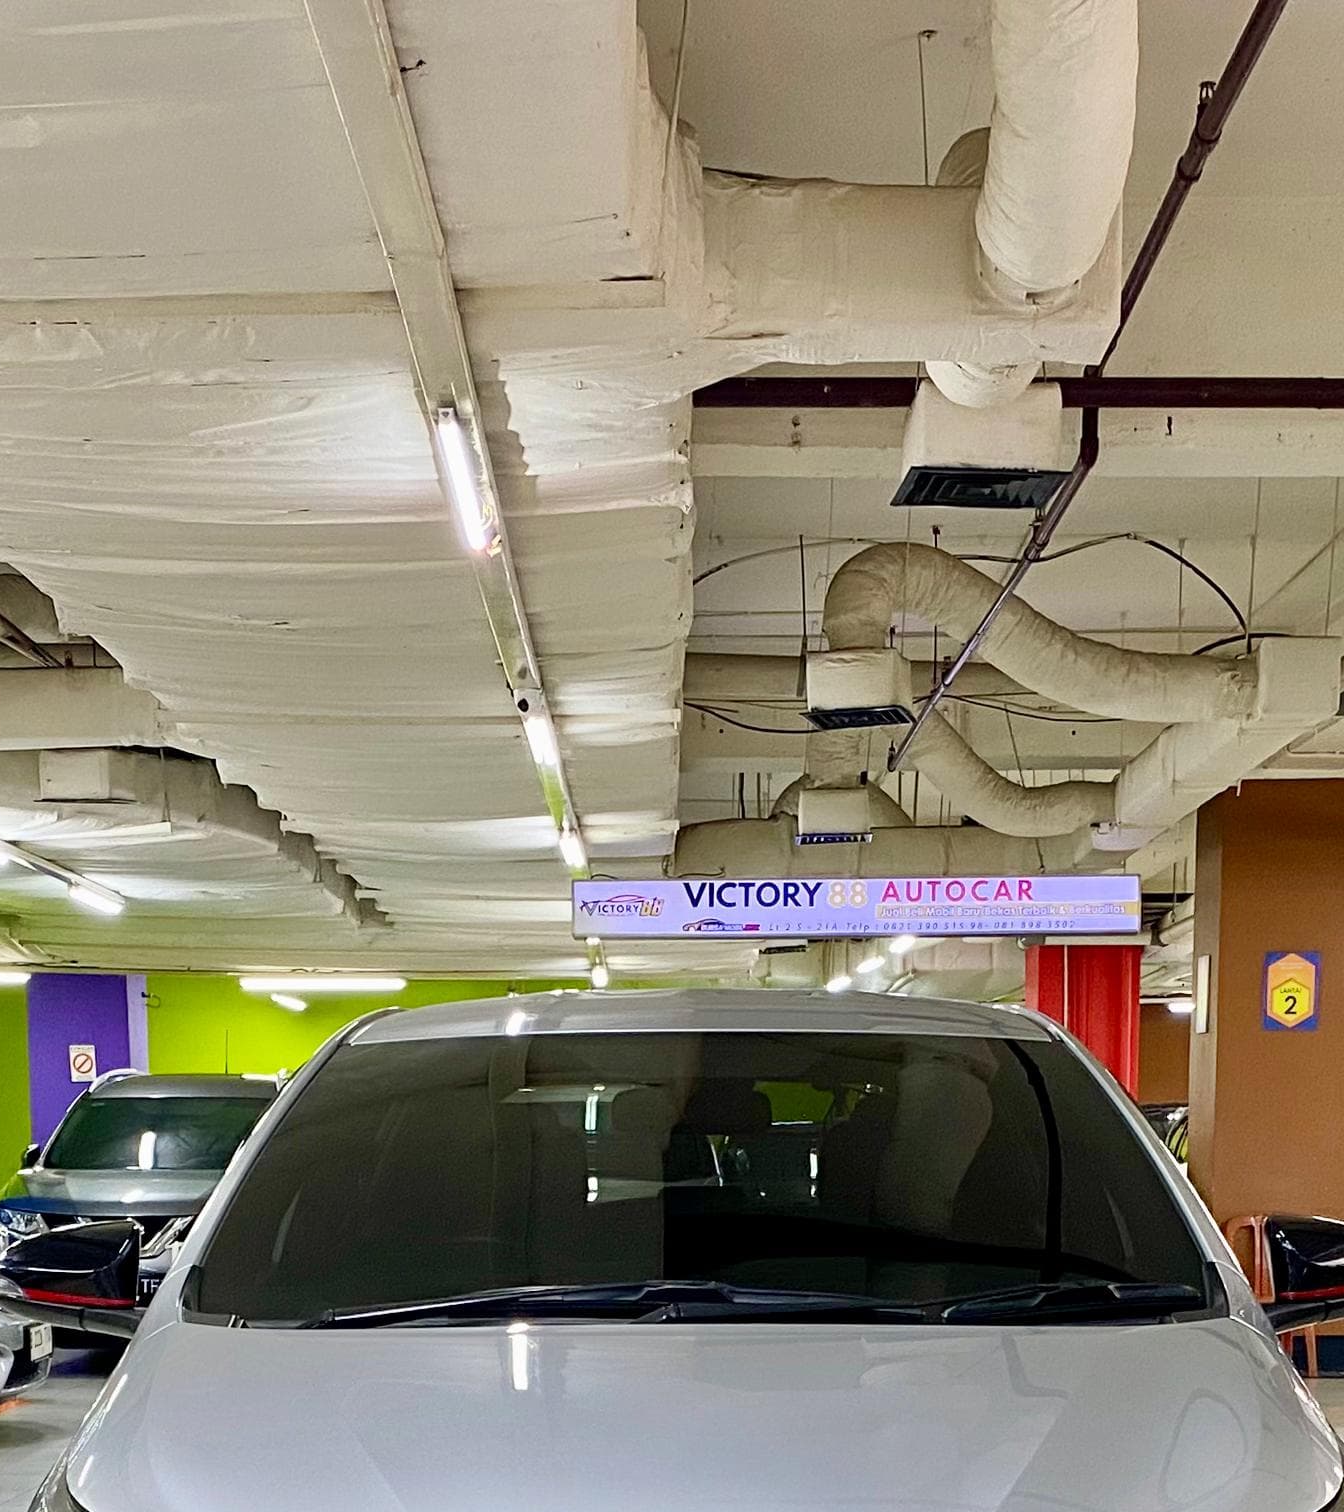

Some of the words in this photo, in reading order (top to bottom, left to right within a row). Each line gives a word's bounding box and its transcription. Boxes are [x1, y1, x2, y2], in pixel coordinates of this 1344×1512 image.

[682, 881, 823, 908] VICTORY
[827, 880, 868, 909] 88
[881, 879, 1033, 903] AUTOCAR
[1284, 995, 1297, 1015] 2
